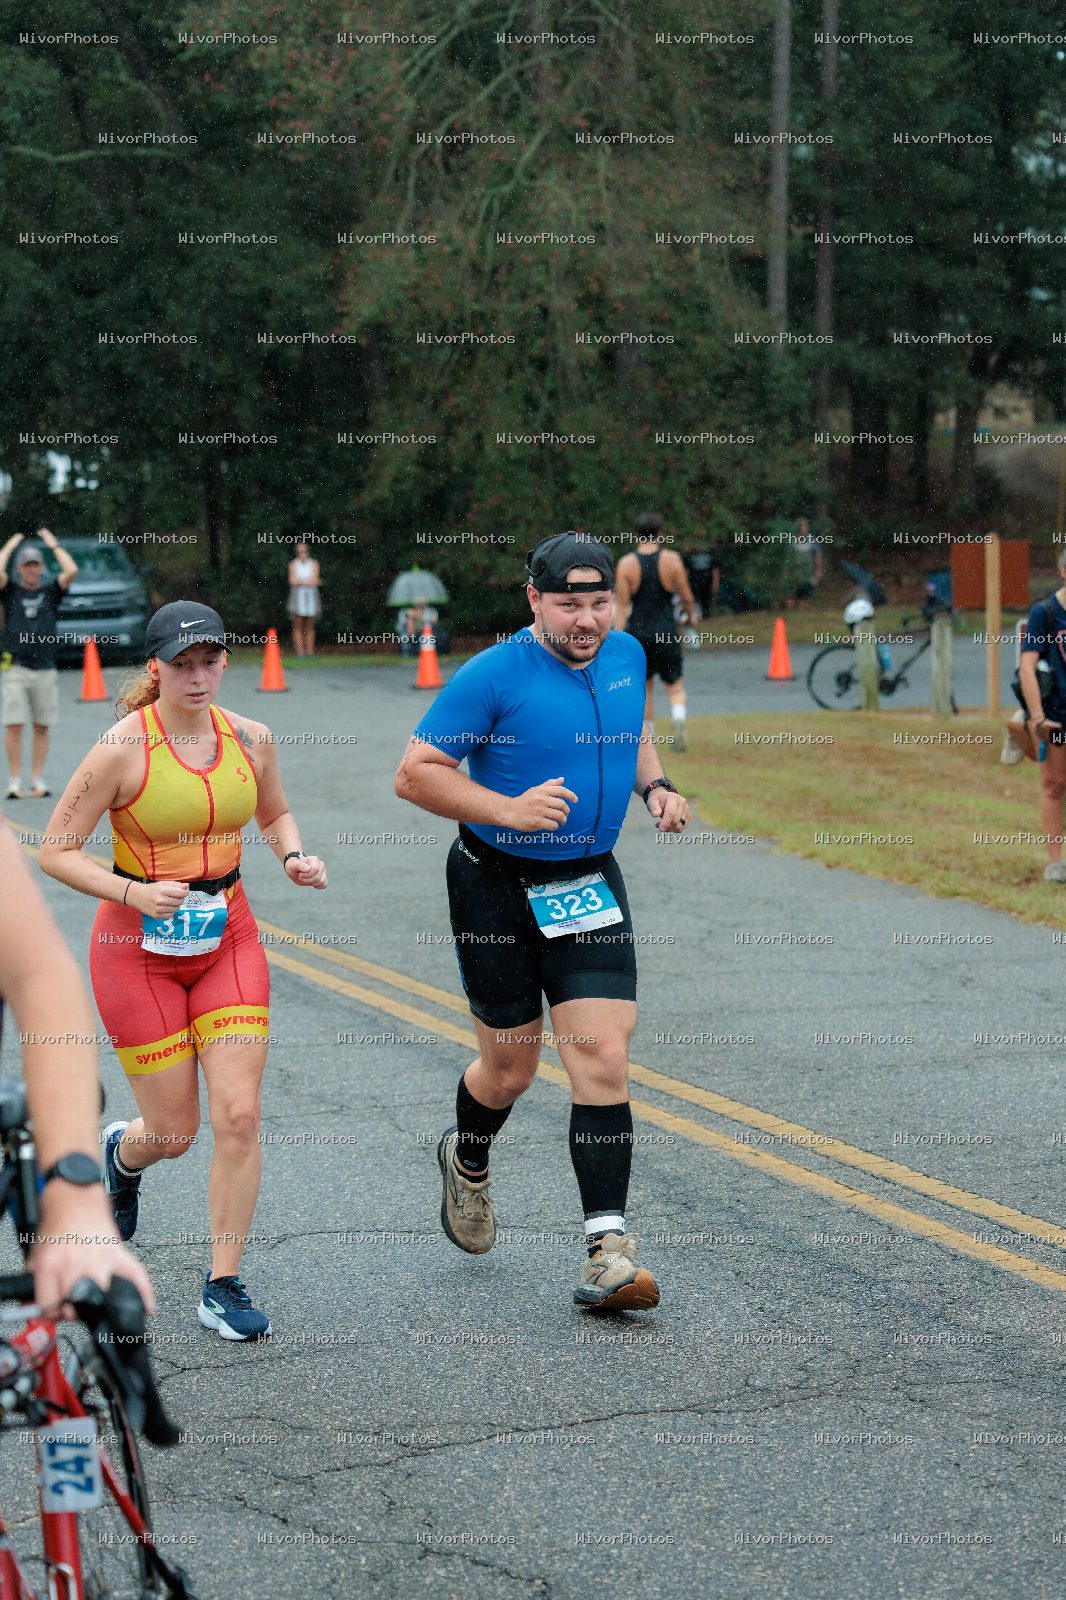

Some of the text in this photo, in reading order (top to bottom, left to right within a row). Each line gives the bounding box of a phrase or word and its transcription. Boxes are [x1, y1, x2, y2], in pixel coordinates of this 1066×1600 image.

[546, 887, 603, 920] 323
[156, 911, 215, 937] 317
[47, 1440, 94, 1497] 247
